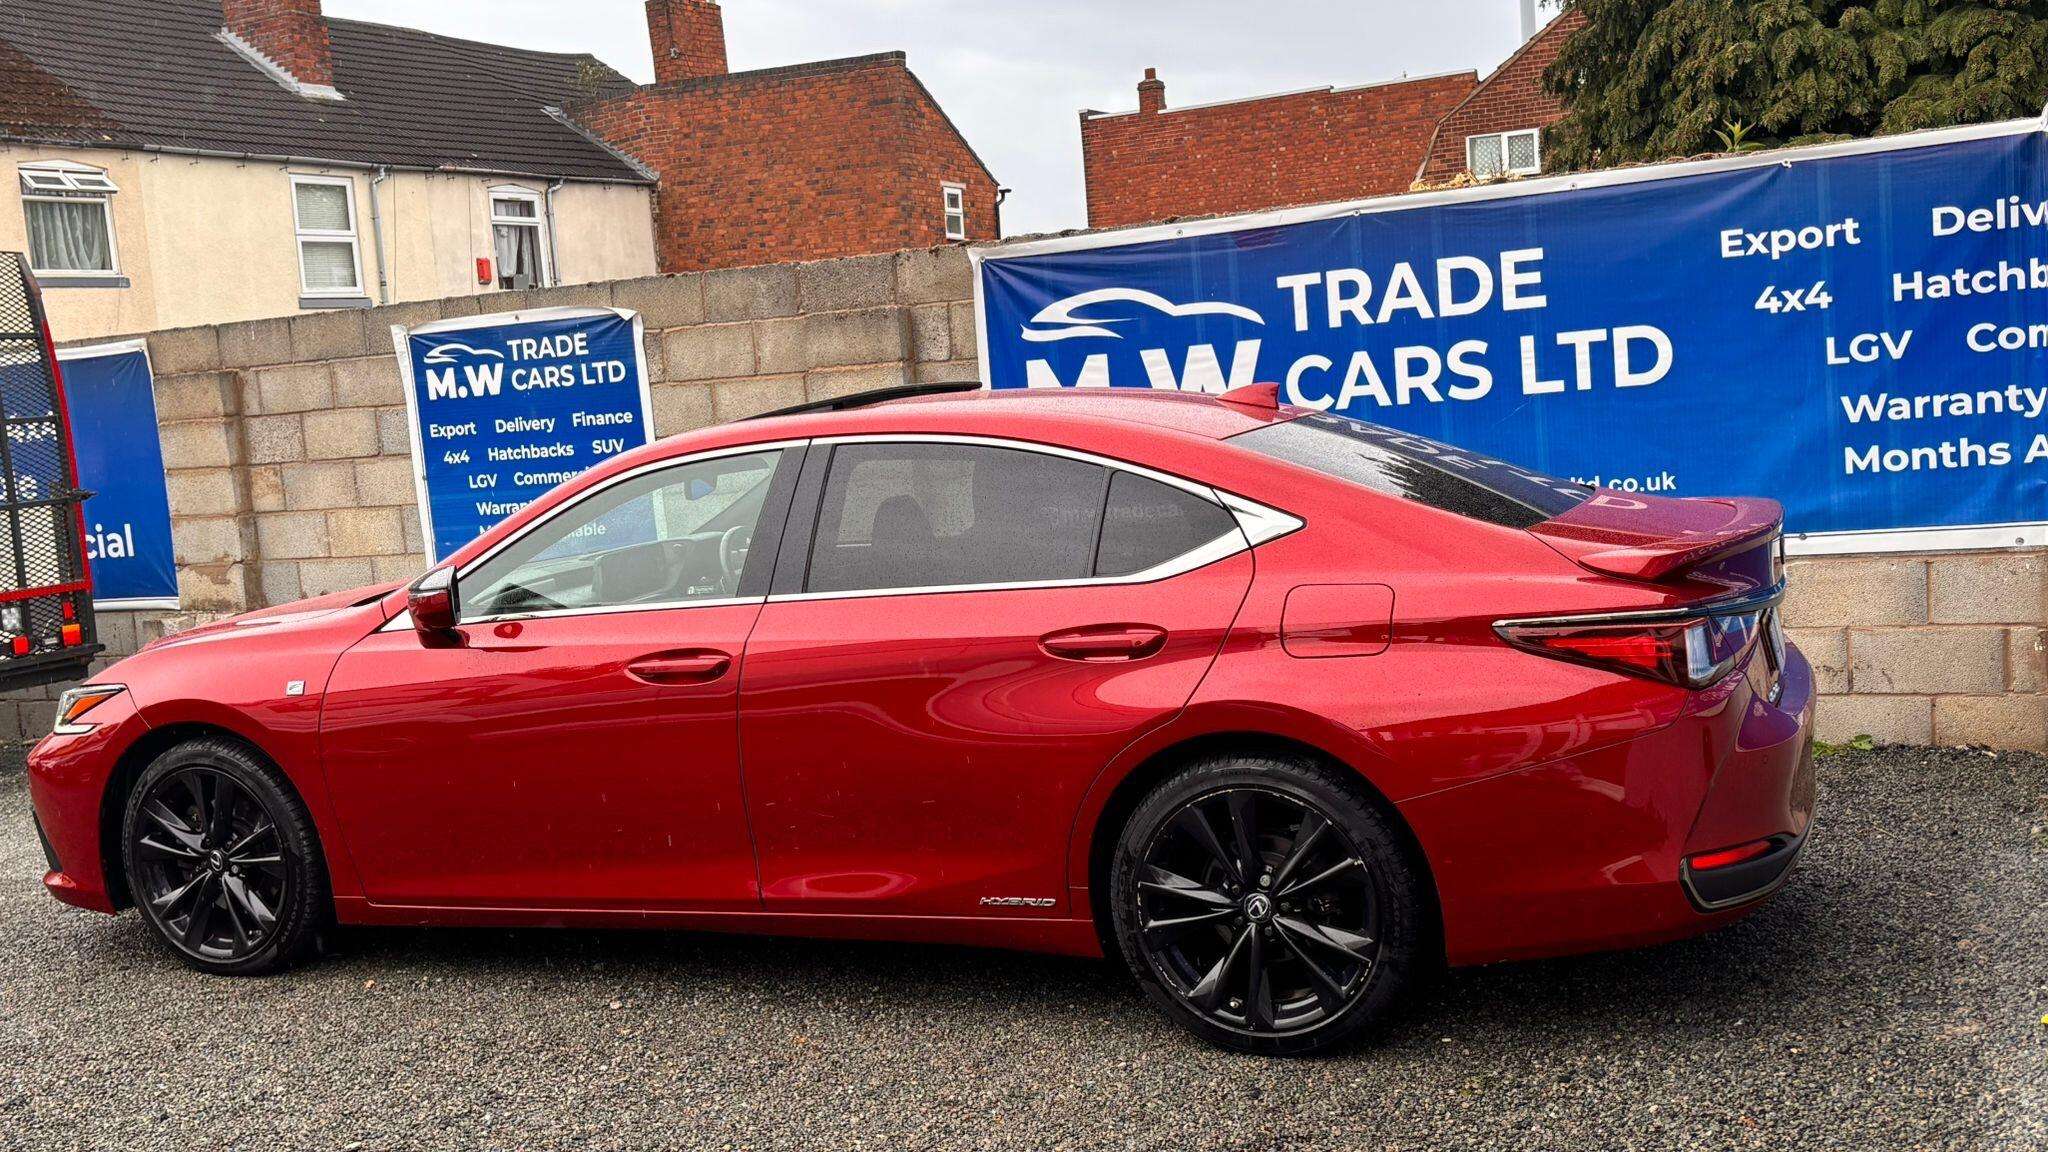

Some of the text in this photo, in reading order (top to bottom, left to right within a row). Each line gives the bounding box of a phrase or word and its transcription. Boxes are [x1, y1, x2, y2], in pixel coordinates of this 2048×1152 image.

[1721, 218, 1860, 259] Export
[1277, 248, 1546, 331] TRADE
[1755, 281, 1832, 313] 4x4
[507, 332, 589, 361] TRADE
[1827, 330, 1912, 364] LGV
[426, 363, 504, 401] M.W
[512, 360, 625, 390] CARS LTD
[1285, 325, 1673, 411] CARS LTD
[1841, 385, 2047, 422] Warranty
[430, 412, 632, 439] Export Delivery Finance
[444, 438, 624, 464] 4x4 Hatchbacks SUV
[1845, 438, 2011, 473] Months
[469, 474, 497, 488] LGV
[980, 896, 1056, 907] HYBRID
